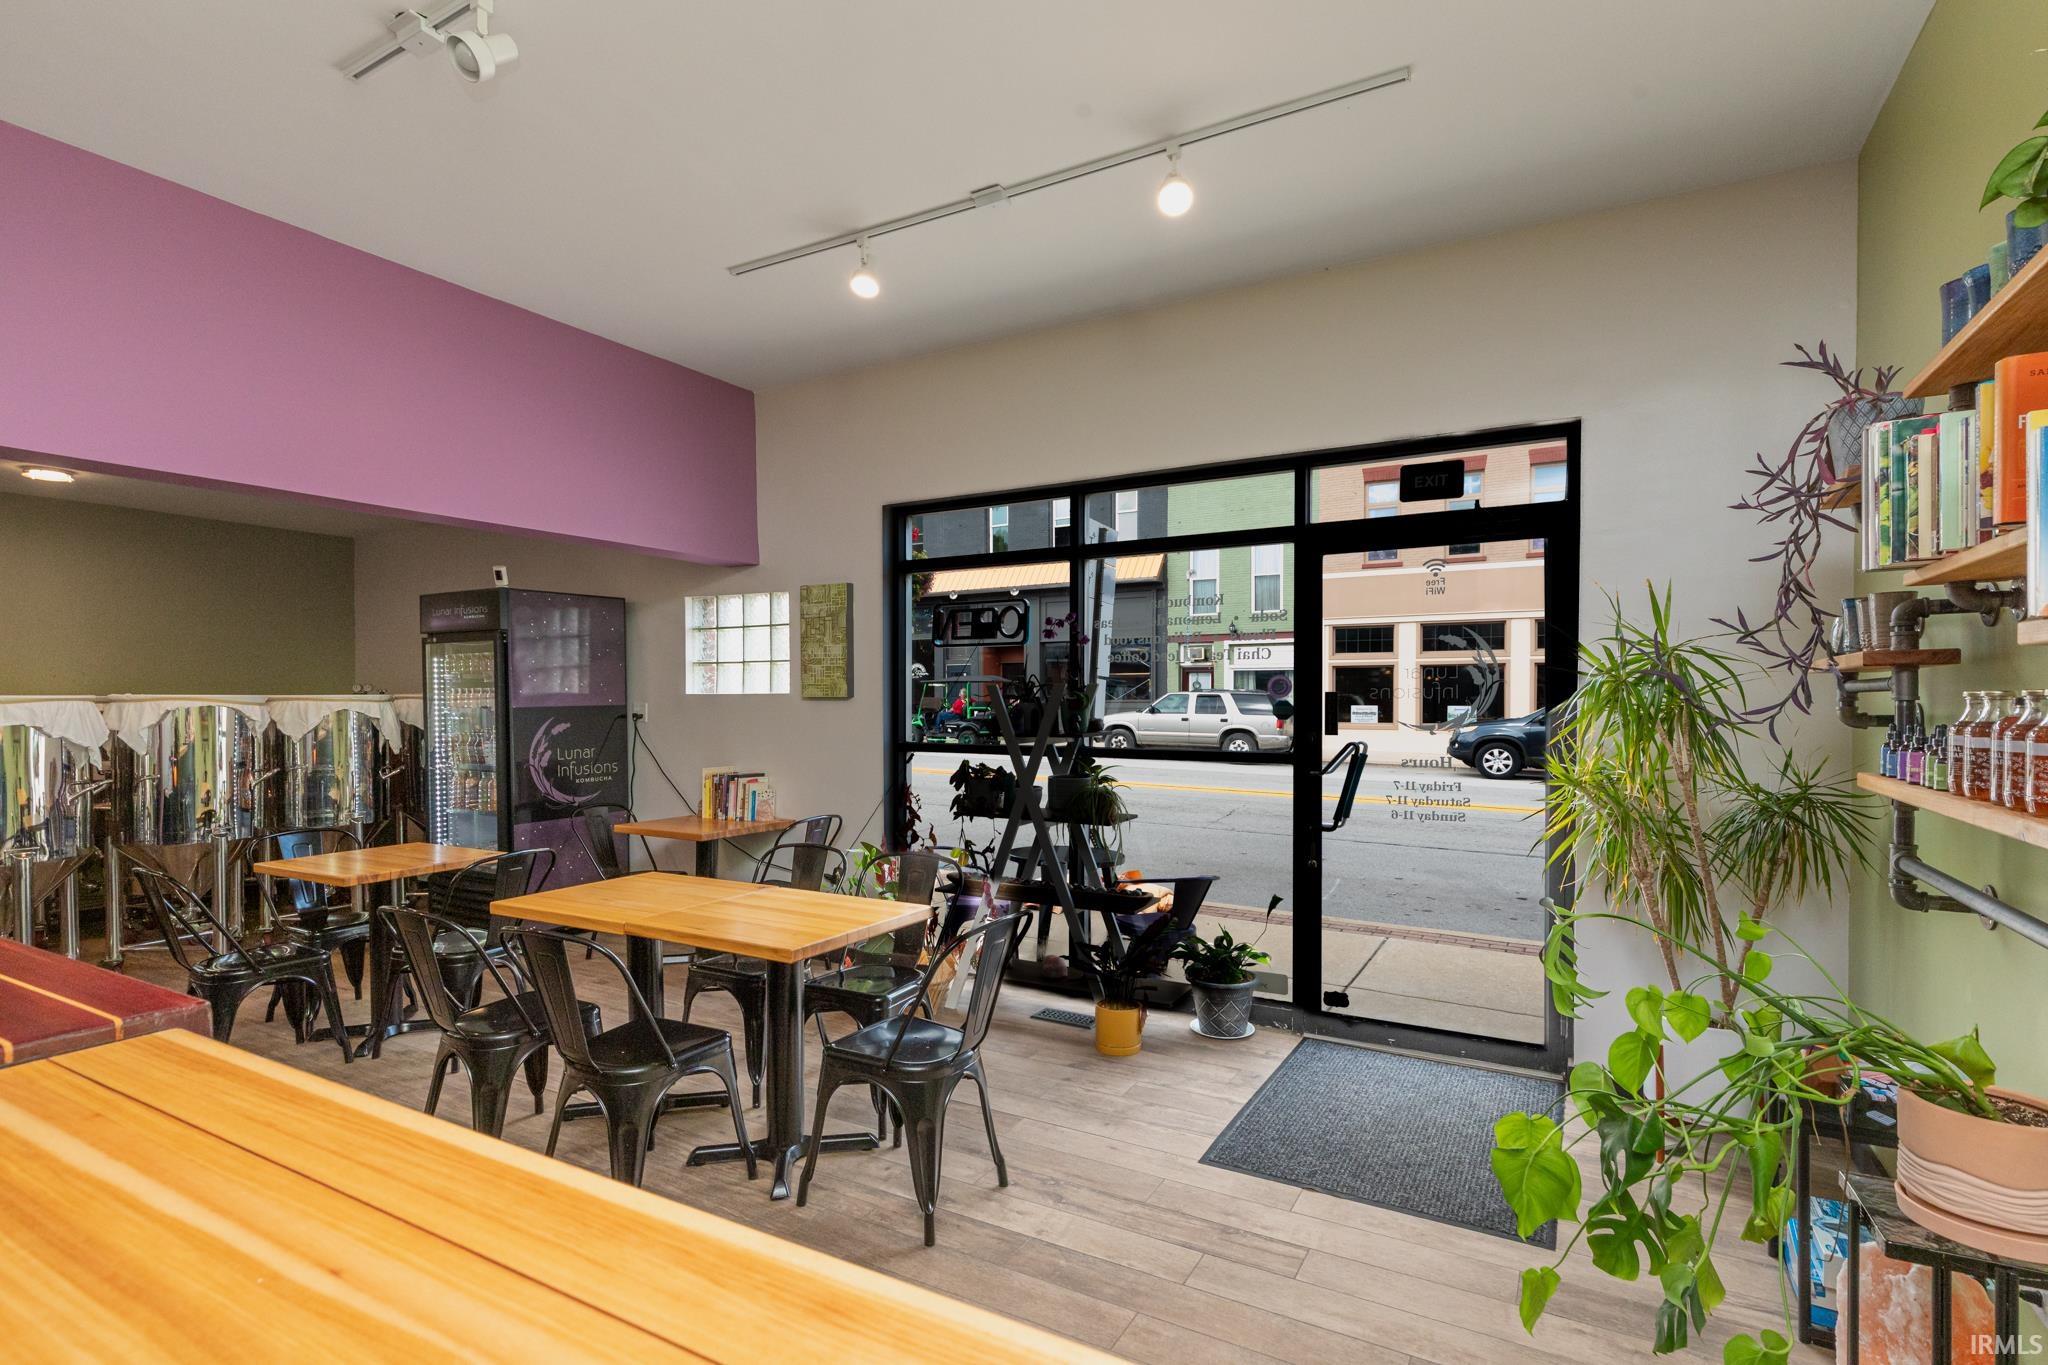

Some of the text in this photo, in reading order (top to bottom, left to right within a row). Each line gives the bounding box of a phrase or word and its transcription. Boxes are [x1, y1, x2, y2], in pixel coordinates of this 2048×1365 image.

[2029, 367, 2048, 377] SA
[1414, 474, 1449, 489] EXIT
[557, 747, 595, 761] Lunar
[557, 761, 618, 780] Infusions
[575, 775, 612, 784] KOMBUCHA
